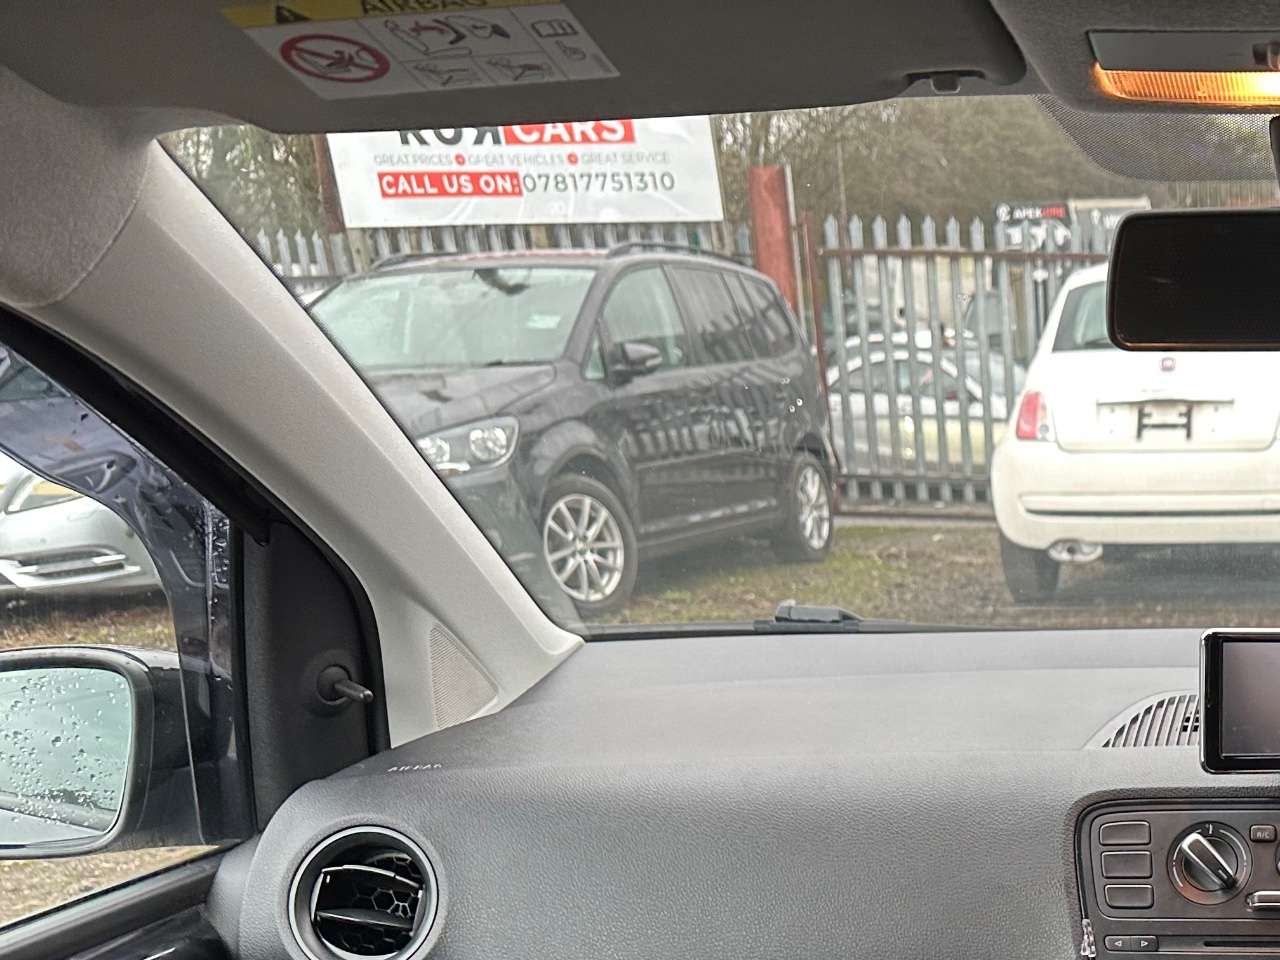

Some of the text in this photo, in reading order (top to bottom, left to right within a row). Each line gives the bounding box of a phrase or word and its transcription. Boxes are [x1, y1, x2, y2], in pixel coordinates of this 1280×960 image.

[381, 171, 675, 195] CALL US ON: 07817751310
